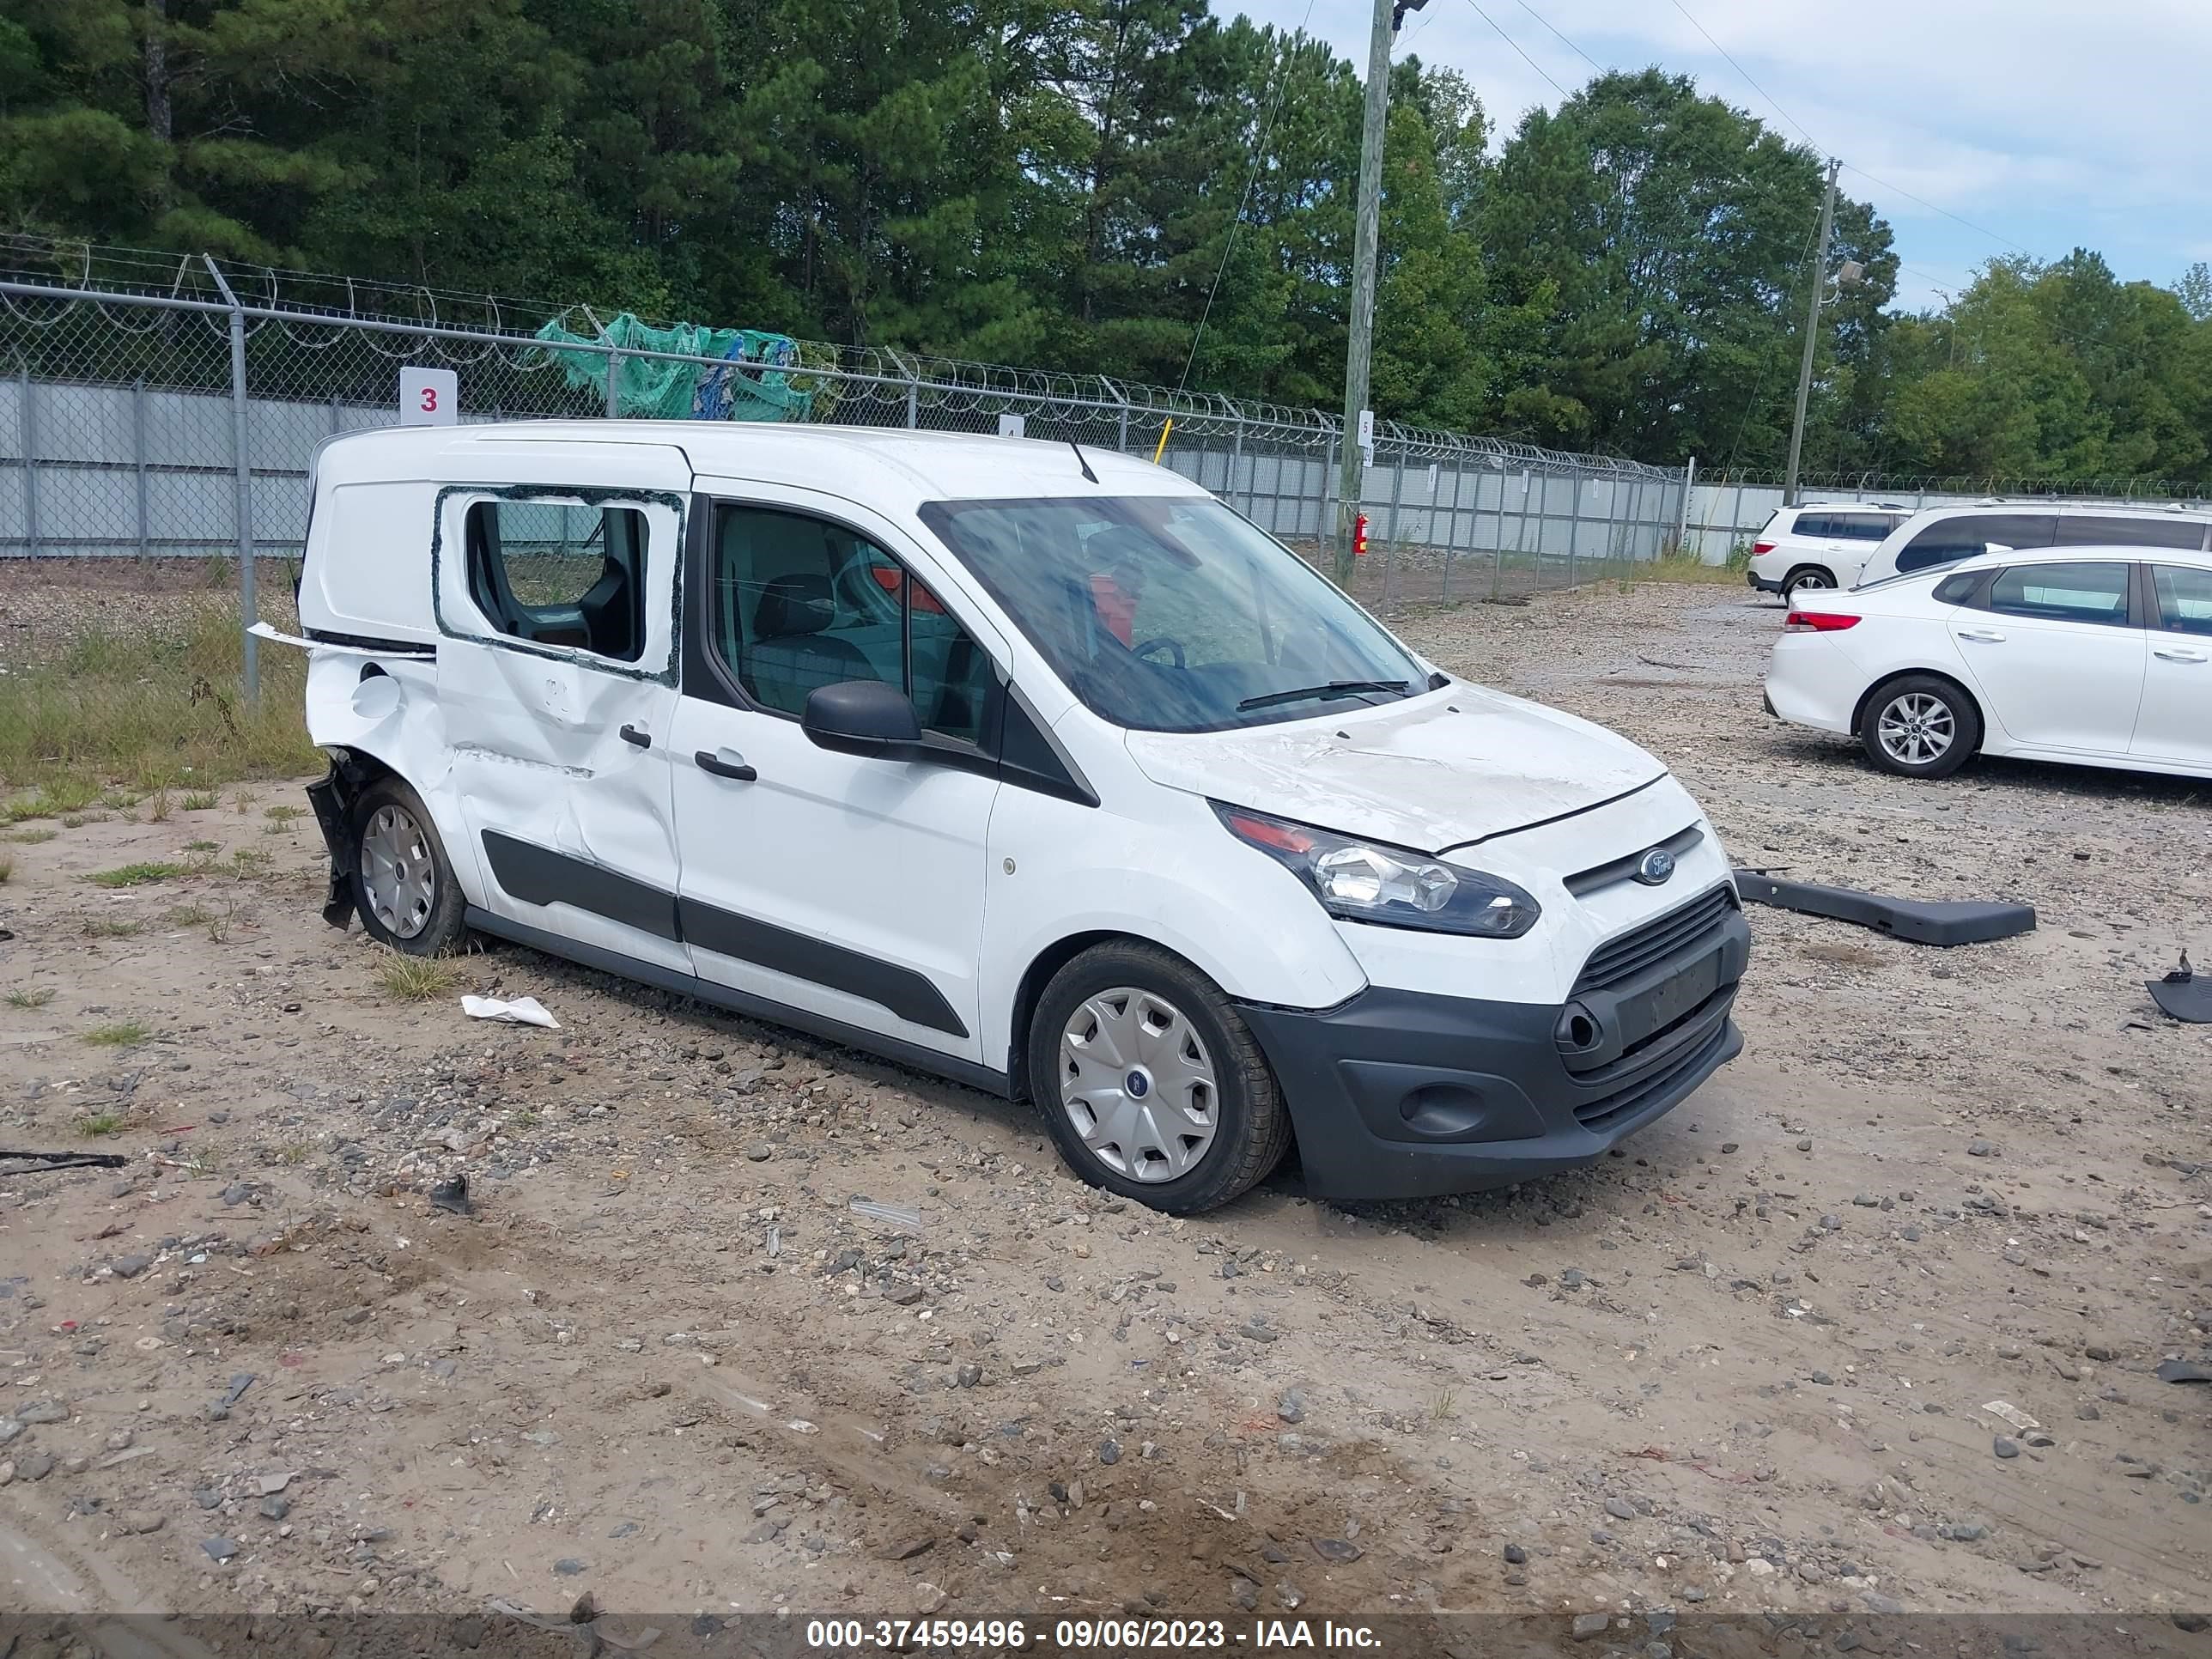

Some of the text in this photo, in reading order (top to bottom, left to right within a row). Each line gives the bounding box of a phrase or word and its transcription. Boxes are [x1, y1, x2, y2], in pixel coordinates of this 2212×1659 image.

[421, 387, 437, 412] 3
[1363, 421, 1369, 434] 5
[1652, 854, 1673, 875] Ford
